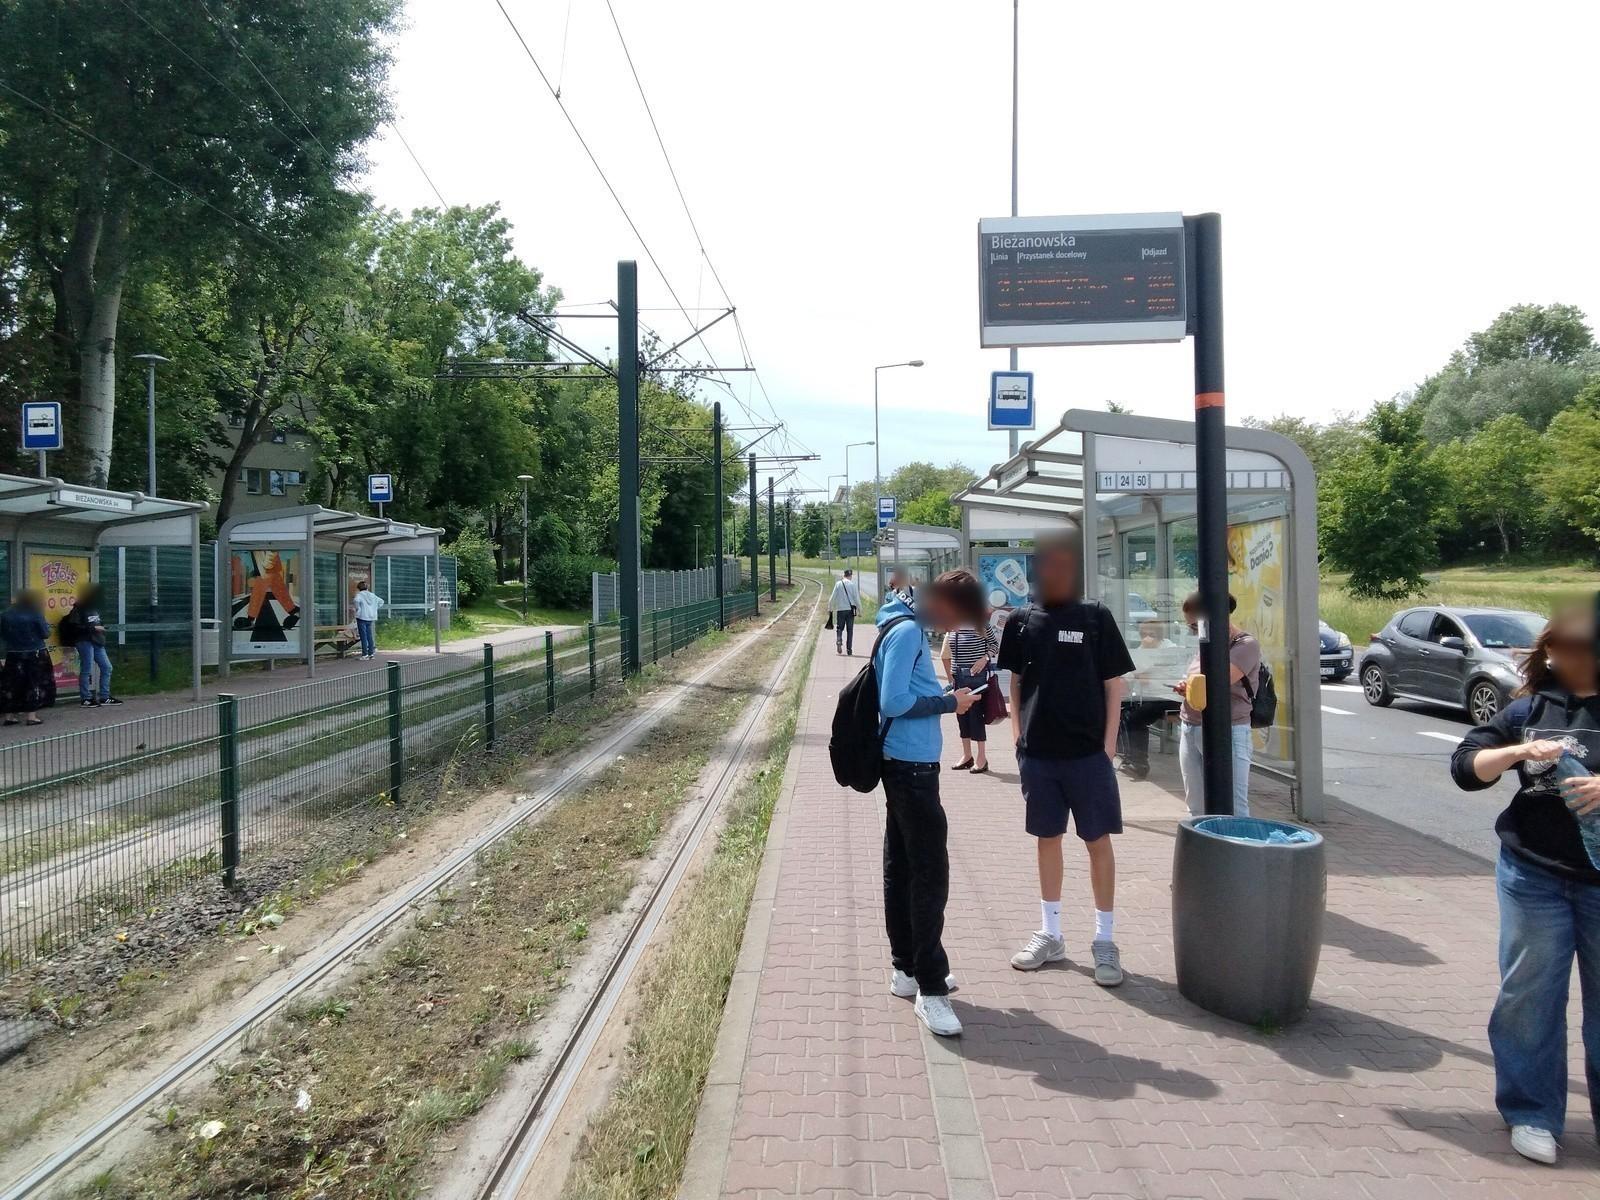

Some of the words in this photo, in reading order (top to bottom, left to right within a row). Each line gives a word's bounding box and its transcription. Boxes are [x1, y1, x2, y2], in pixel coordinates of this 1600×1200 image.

[991, 232, 1077, 249] Bieżanowska
[993, 252, 1009, 261] Linia
[1020, 251, 1055, 261] Przystanek
[1055, 250, 1087, 260] docelowy
[1144, 247, 1168, 258] Odjazd
[1104, 475, 1112, 487] 11
[1120, 475, 1130, 487] 24
[1136, 475, 1147, 487] 50
